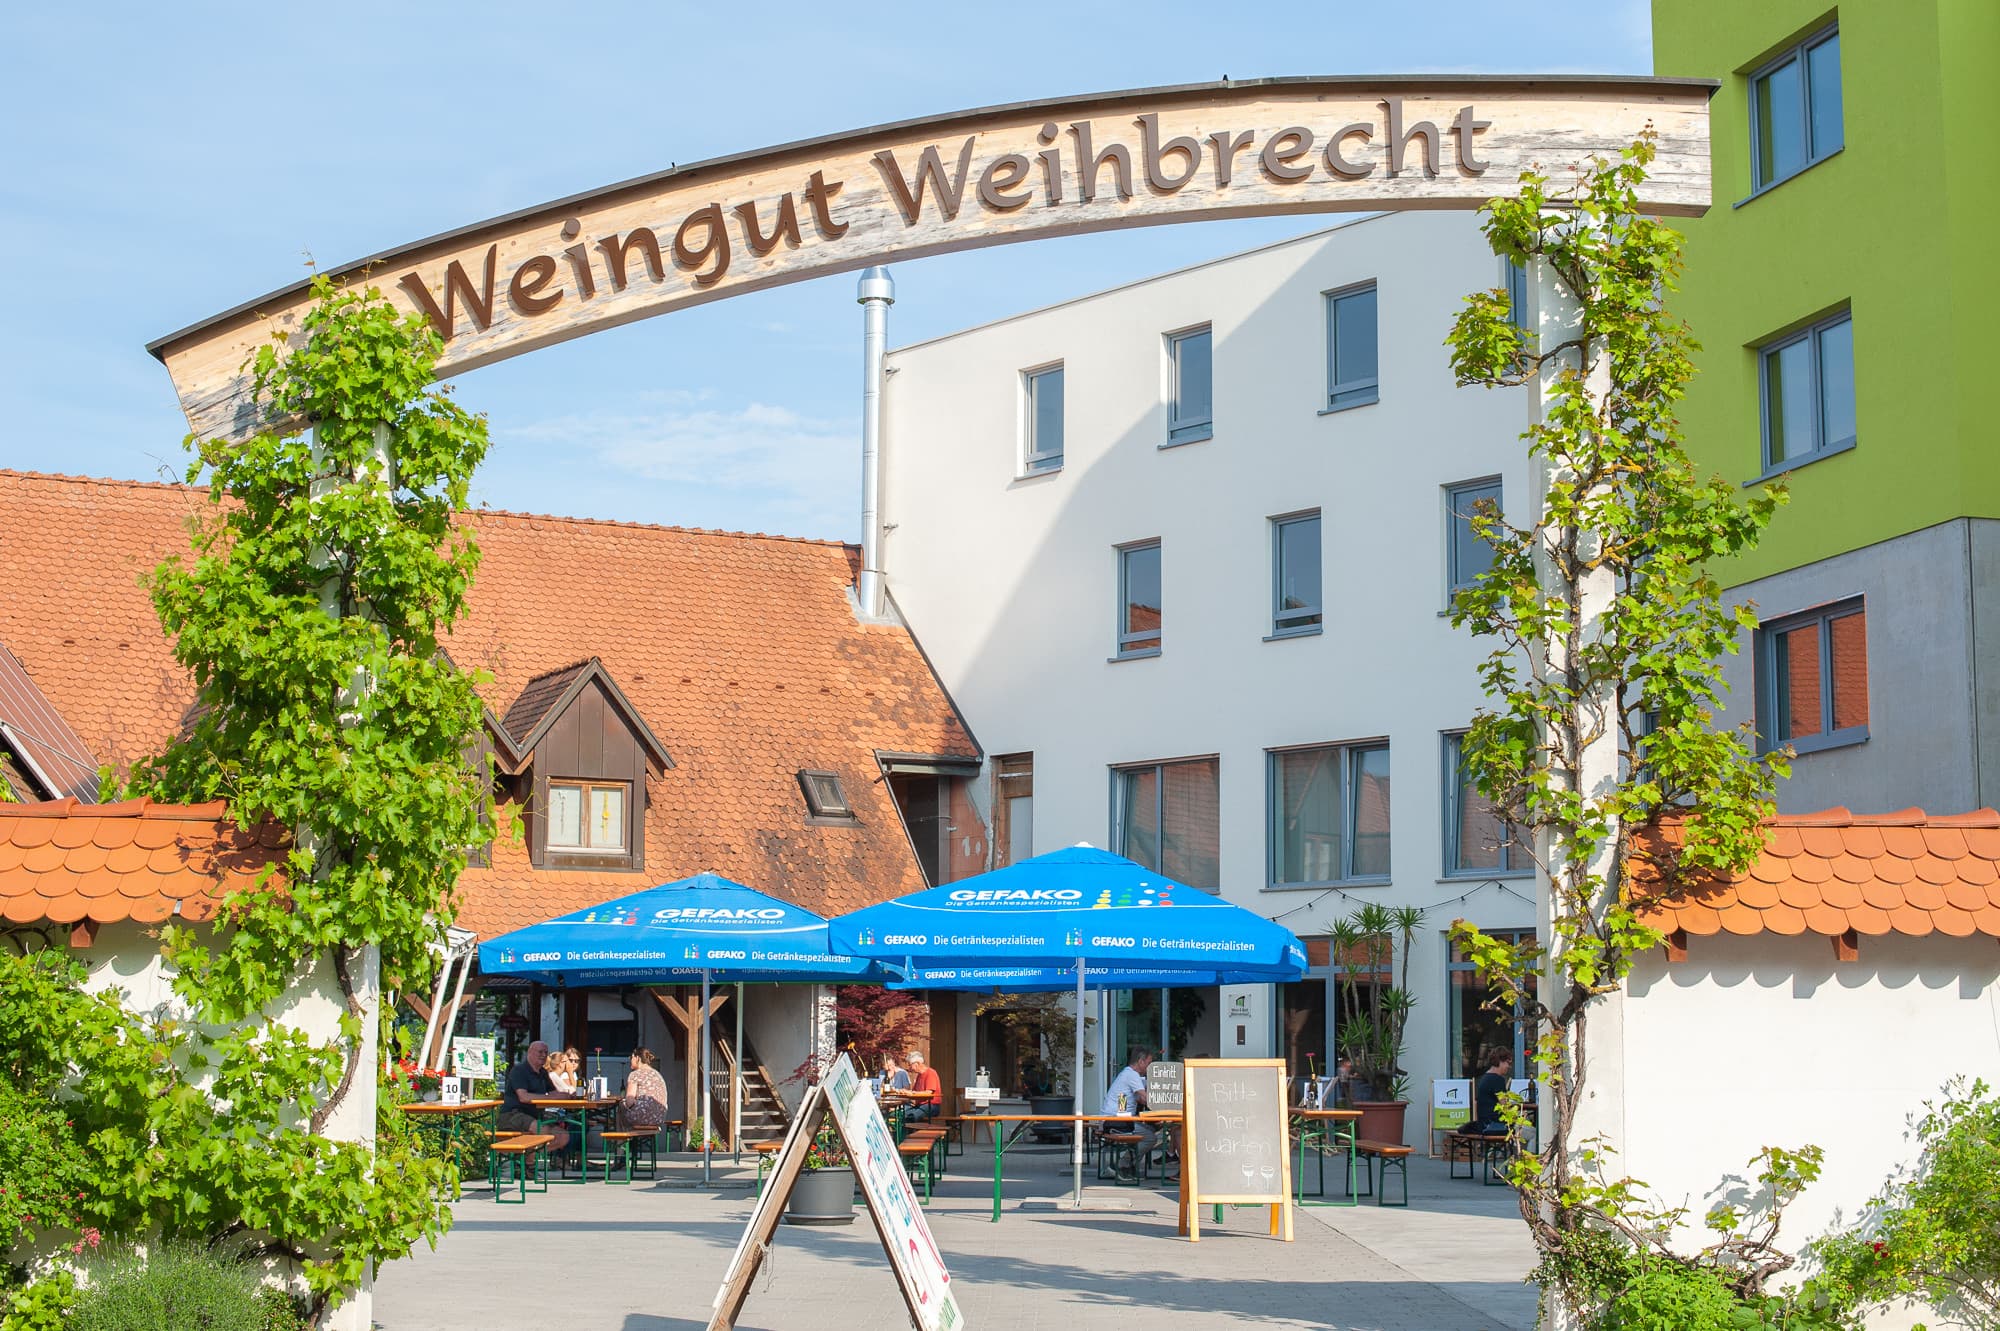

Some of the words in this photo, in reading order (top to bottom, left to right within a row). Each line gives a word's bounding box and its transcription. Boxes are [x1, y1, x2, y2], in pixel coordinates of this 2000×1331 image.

[399, 169, 850, 341] Weingut
[872, 98, 1492, 227] Weihbrecht
[949, 889, 1083, 901] GEFAKO
[654, 908, 786, 920] GEFAKO
[671, 918, 783, 926] Getränkespezialisten
[884, 934, 927, 945] GEFAKO
[933, 935, 949, 945] Die
[950, 934, 1045, 947] Getränkespezialisten
[1091, 936, 1136, 948] GEFAKO
[1142, 937, 1158, 948] Die
[1159, 938, 1255, 952] Getränkespezialisten
[523, 952, 561, 962] GEFAKO
[567, 951, 581, 961] Die
[582, 950, 666, 961] Getränkespezialisten
[707, 950, 746, 960] GEFAKO
[751, 951, 766, 961] Die
[767, 951, 851, 963] Getränkespezialisten
[925, 970, 957, 980] GEFAKO
[960, 969, 972, 978] Die
[973, 968, 1042, 979] Getränkespezialisten
[1152, 1064, 1177, 1079] Eintritt
[446, 1084, 458, 1094] 10
[1212, 1081, 1257, 1102] Bitte
[1216, 1110, 1249, 1129] hier
[1205, 1134, 1272, 1153] warten
